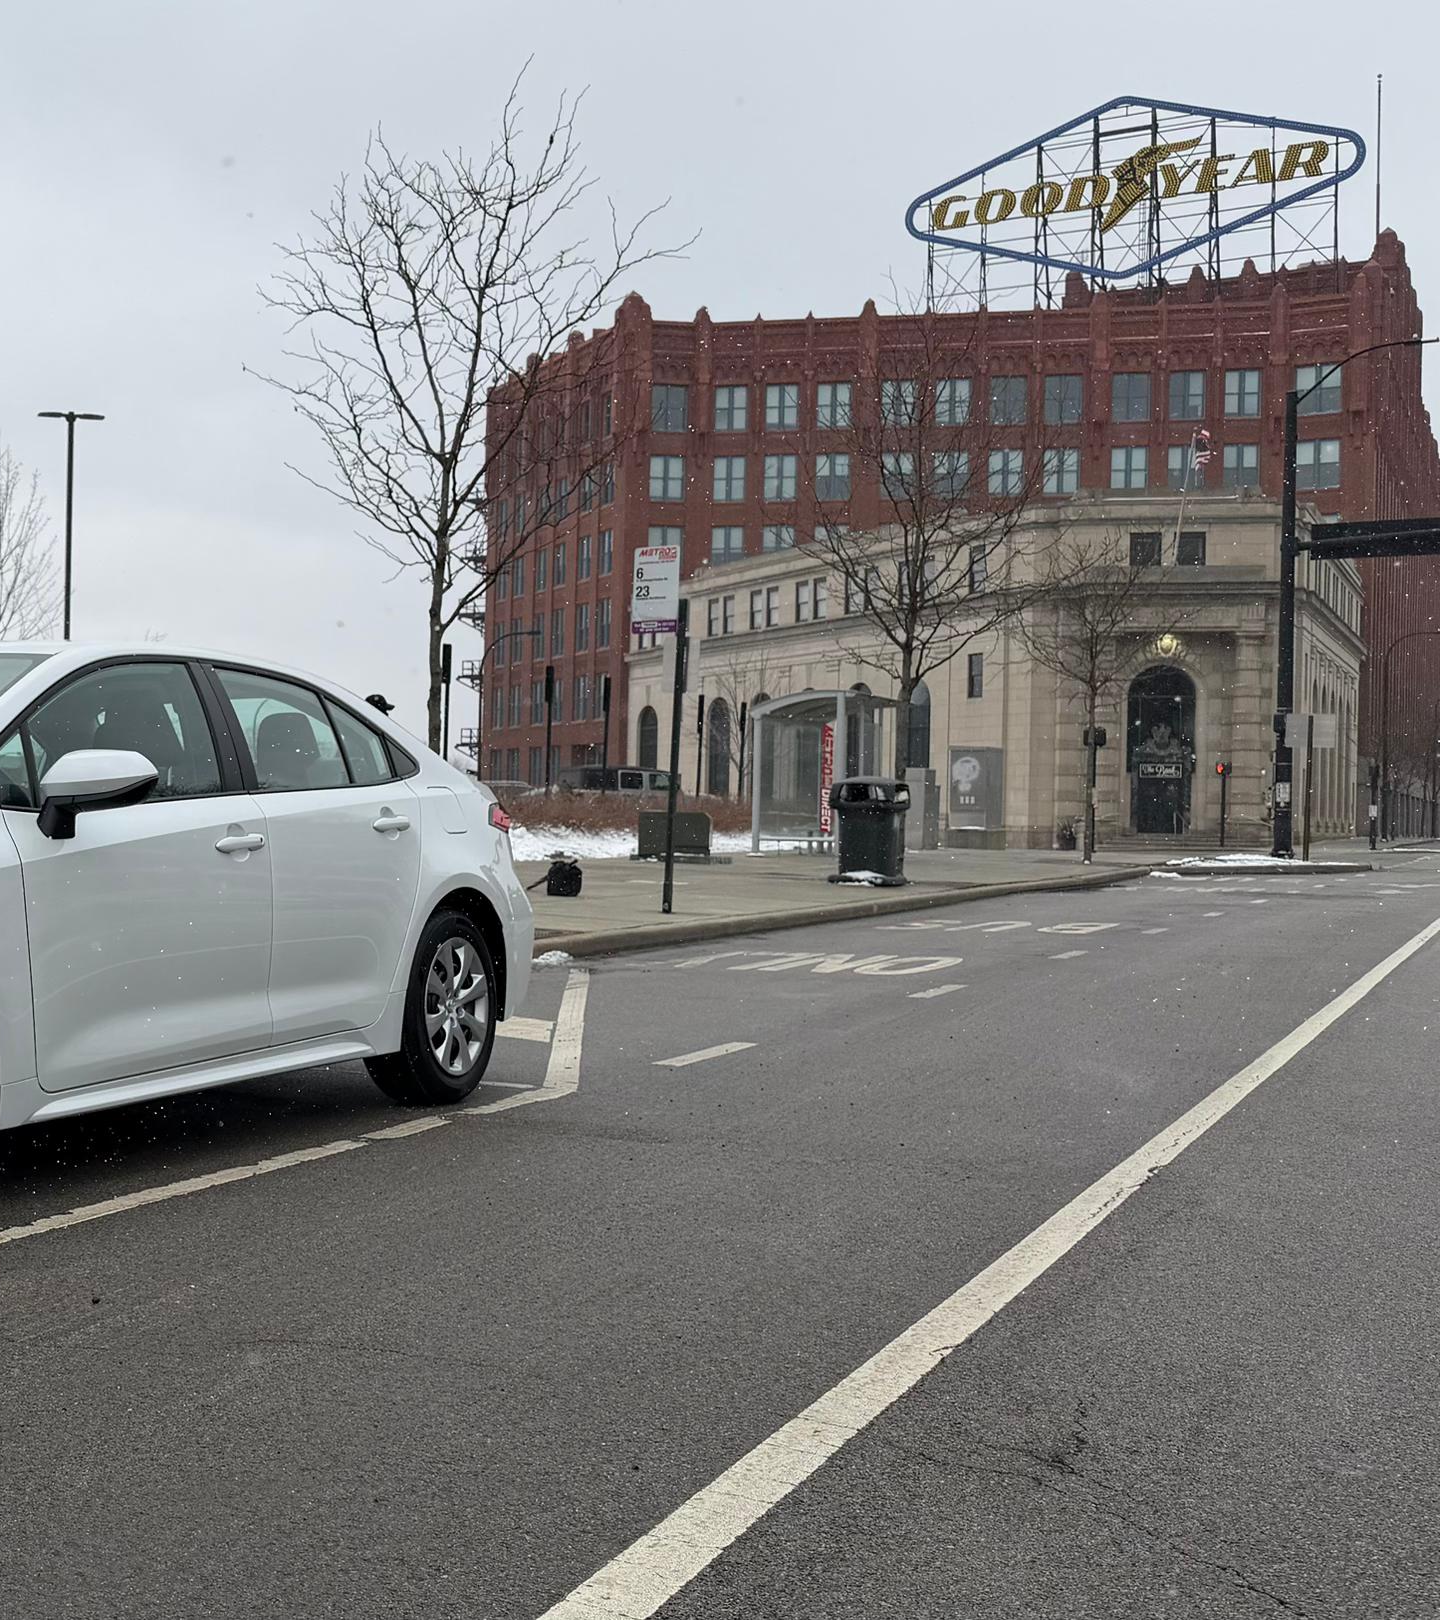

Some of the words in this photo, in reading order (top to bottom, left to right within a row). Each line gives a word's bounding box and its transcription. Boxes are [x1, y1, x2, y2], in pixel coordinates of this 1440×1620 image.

[636, 568, 644, 579] 6
[635, 585, 650, 597] 23
[820, 788, 832, 833] DIRECT
[875, 919, 1120, 934] BUS
[648, 951, 964, 976] ONLY
